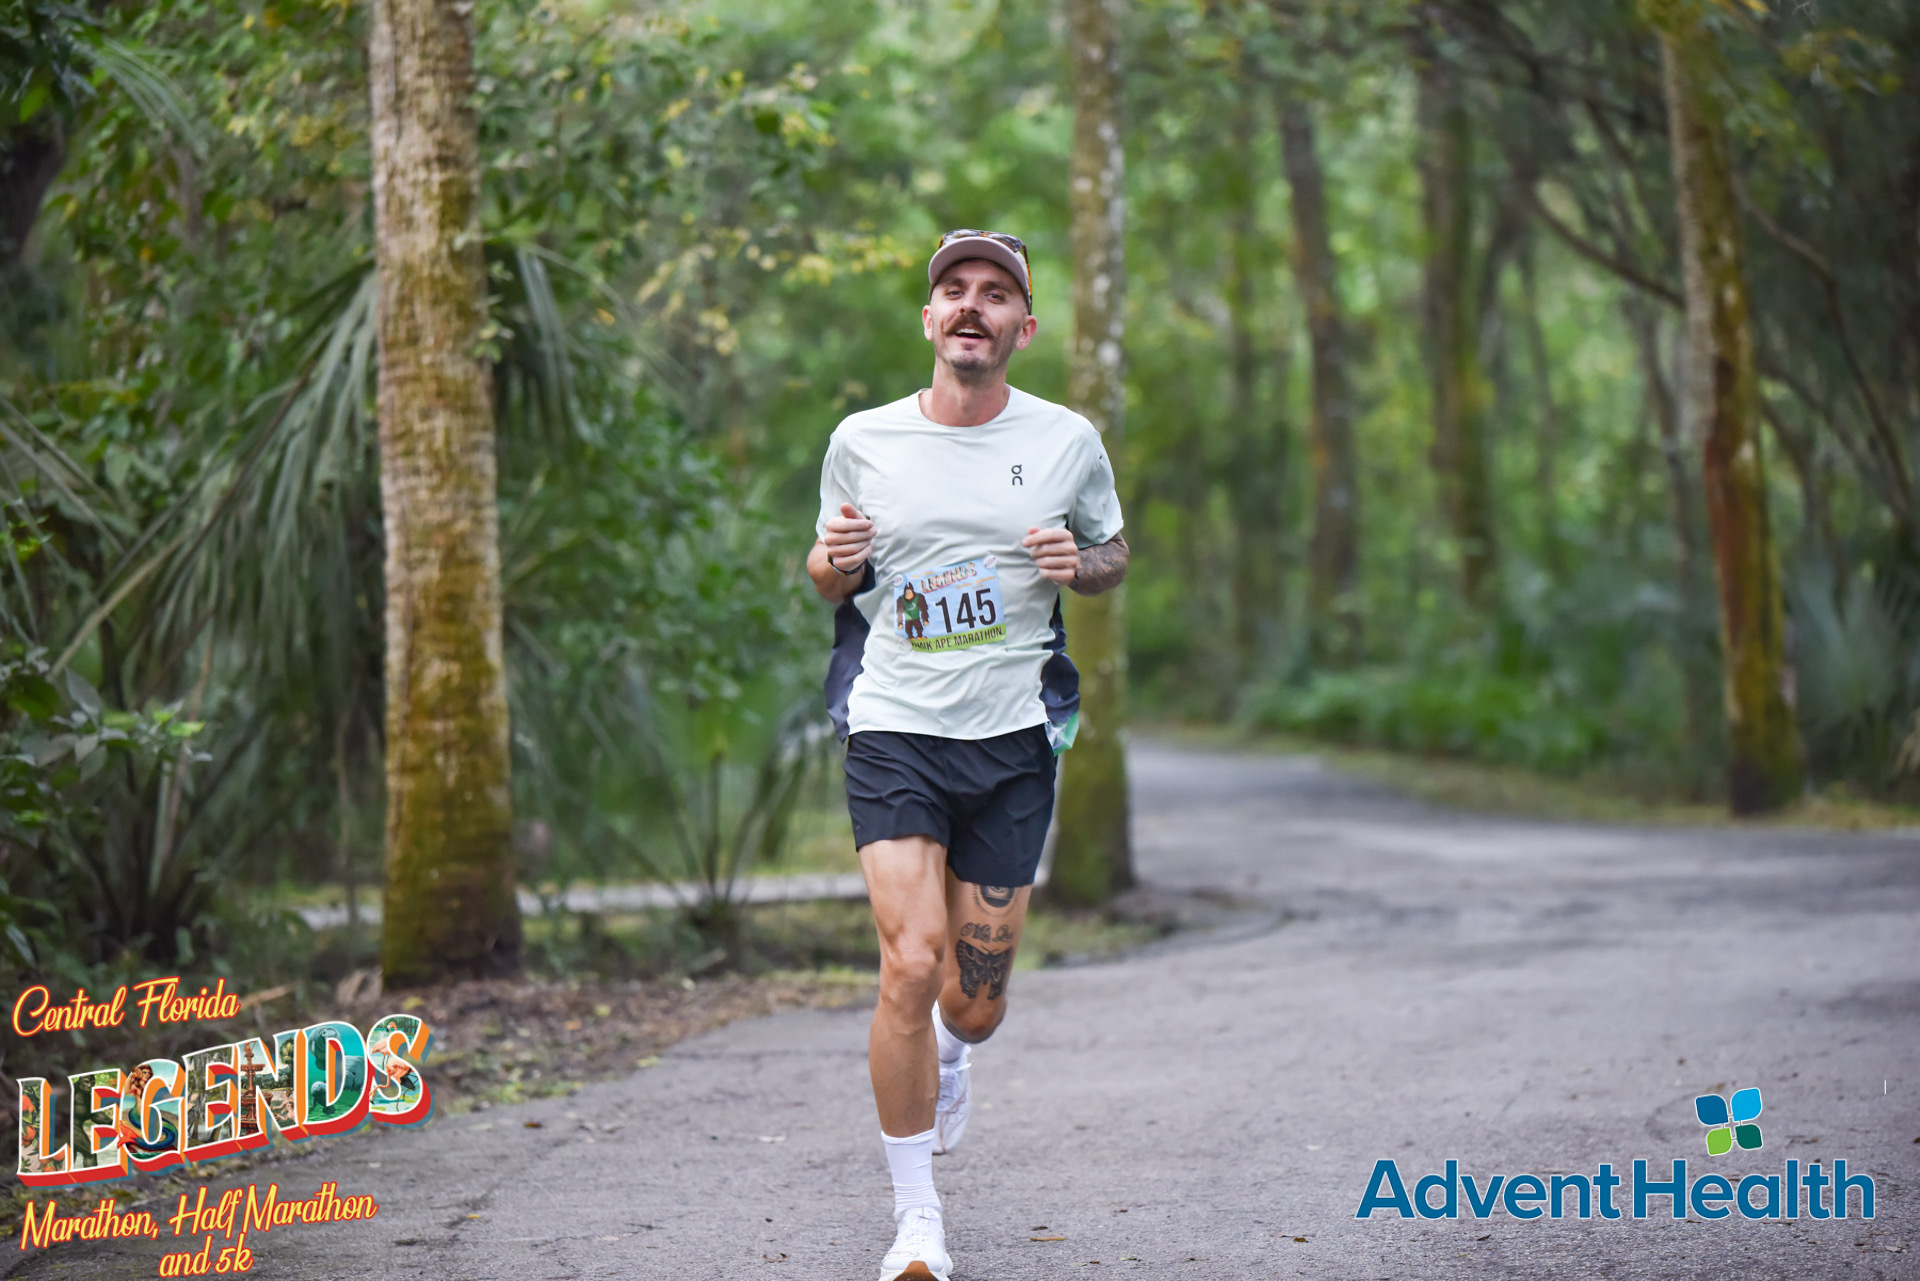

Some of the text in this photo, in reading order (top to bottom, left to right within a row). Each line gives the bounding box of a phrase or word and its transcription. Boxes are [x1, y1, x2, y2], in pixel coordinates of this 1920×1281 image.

[935, 588, 996, 633] 145
[935, 638, 952, 650] APE
[953, 626, 1003, 646] MARATHON
